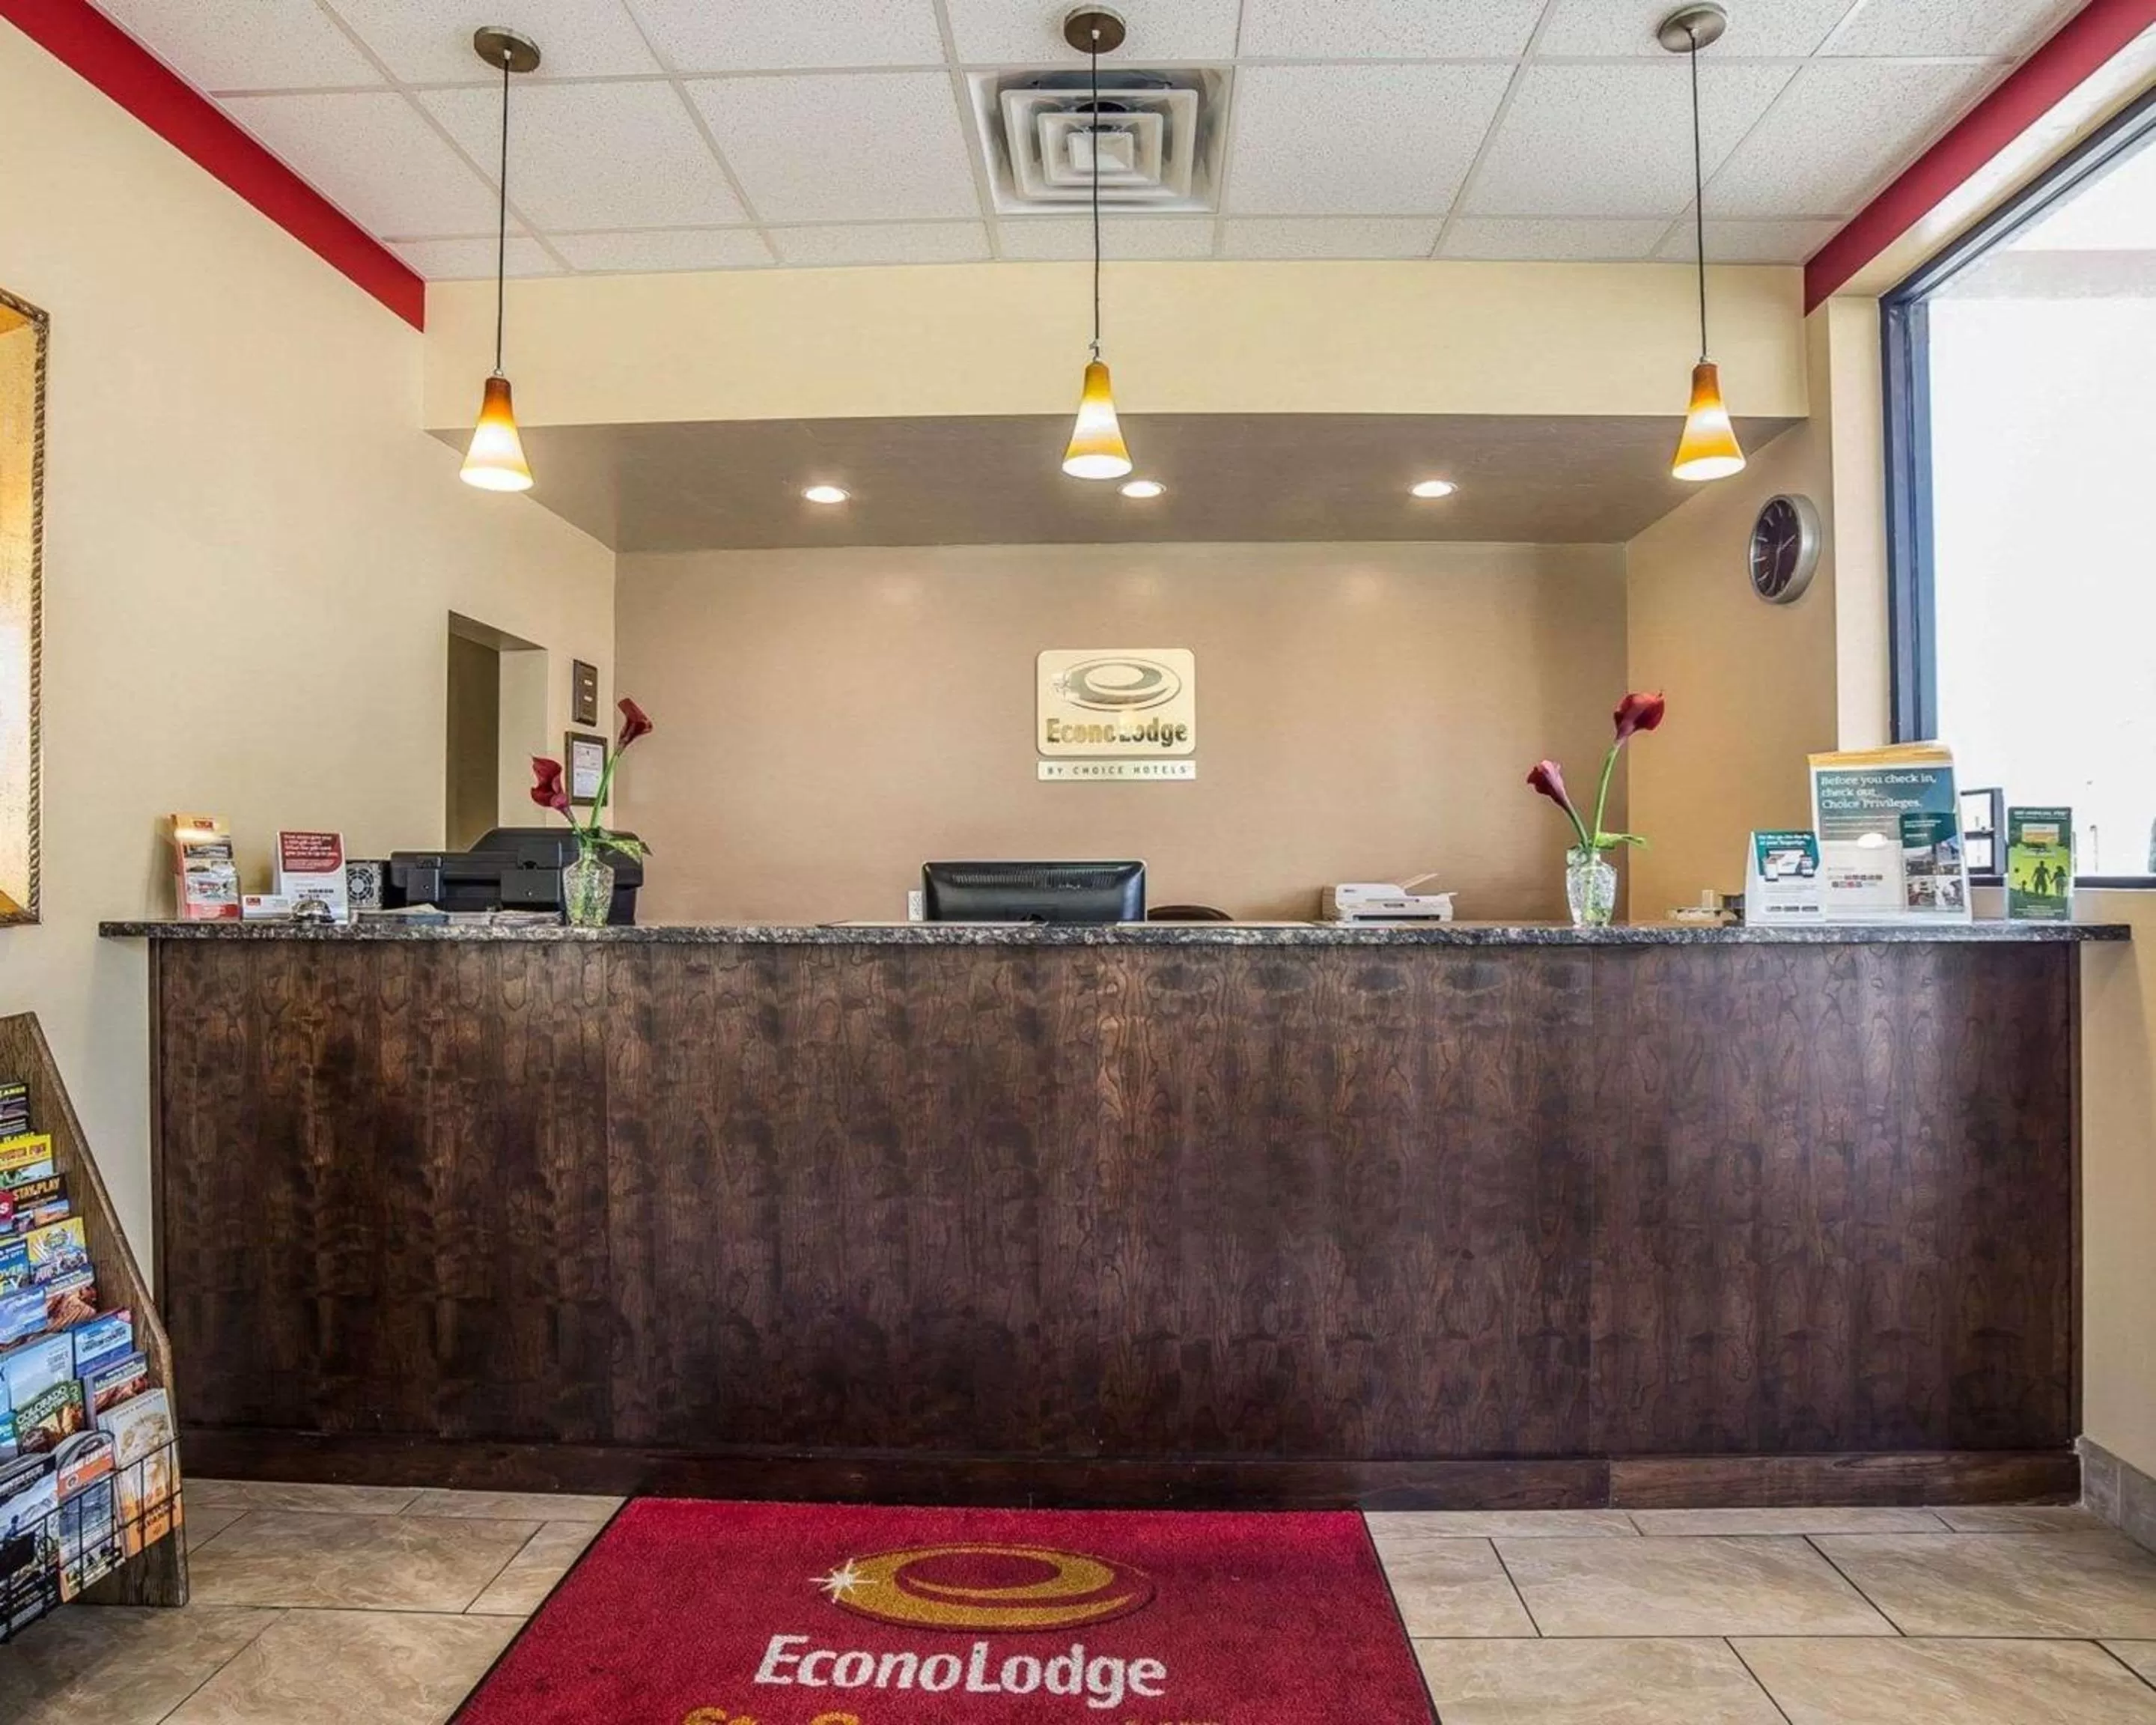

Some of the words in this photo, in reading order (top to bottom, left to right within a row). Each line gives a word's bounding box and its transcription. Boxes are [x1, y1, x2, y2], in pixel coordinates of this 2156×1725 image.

[1048, 766, 1064, 776] BY
[1073, 766, 1123, 776] CHOICE
[1133, 765, 1187, 775] HOTELS
[1821, 776, 1859, 786] Before
[1860, 775, 1883, 787] you
[1884, 773, 1919, 784] check
[1821, 788, 1854, 798] check
[1821, 799, 1860, 809] Choice
[16, 1385, 68, 1425] COLORADO
[754, 1634, 1168, 1709] EconoLodge
